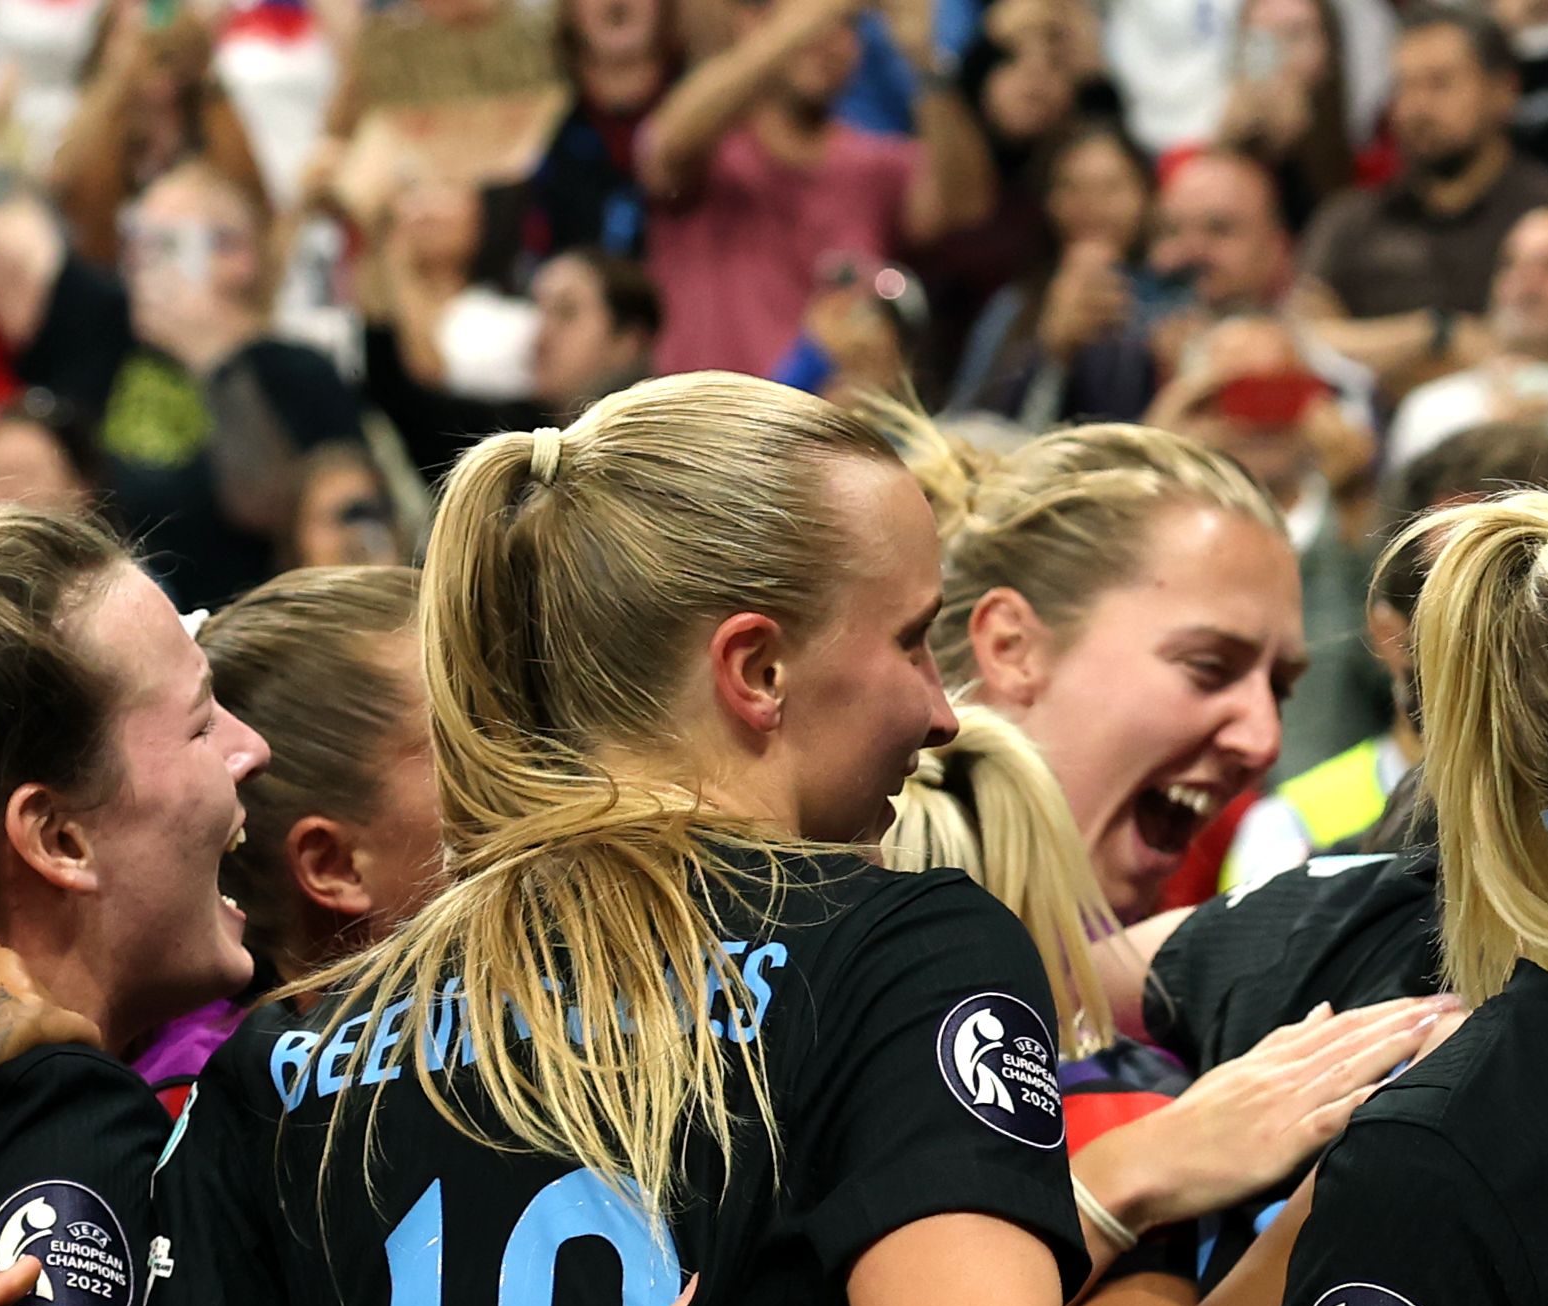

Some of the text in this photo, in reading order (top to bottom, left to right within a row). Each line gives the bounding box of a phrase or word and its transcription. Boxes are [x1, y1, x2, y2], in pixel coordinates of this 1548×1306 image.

[1015, 1040, 1048, 1066] UEFA
[1002, 1053, 1058, 1090] EUROPEAN
[1020, 1086, 1057, 1118] 2022
[68, 1223, 109, 1249] UEFA
[45, 1252, 127, 1287] CHAMPIONS
[50, 1239, 124, 1272] EUROPEAN
[65, 1271, 113, 1299] 2022
